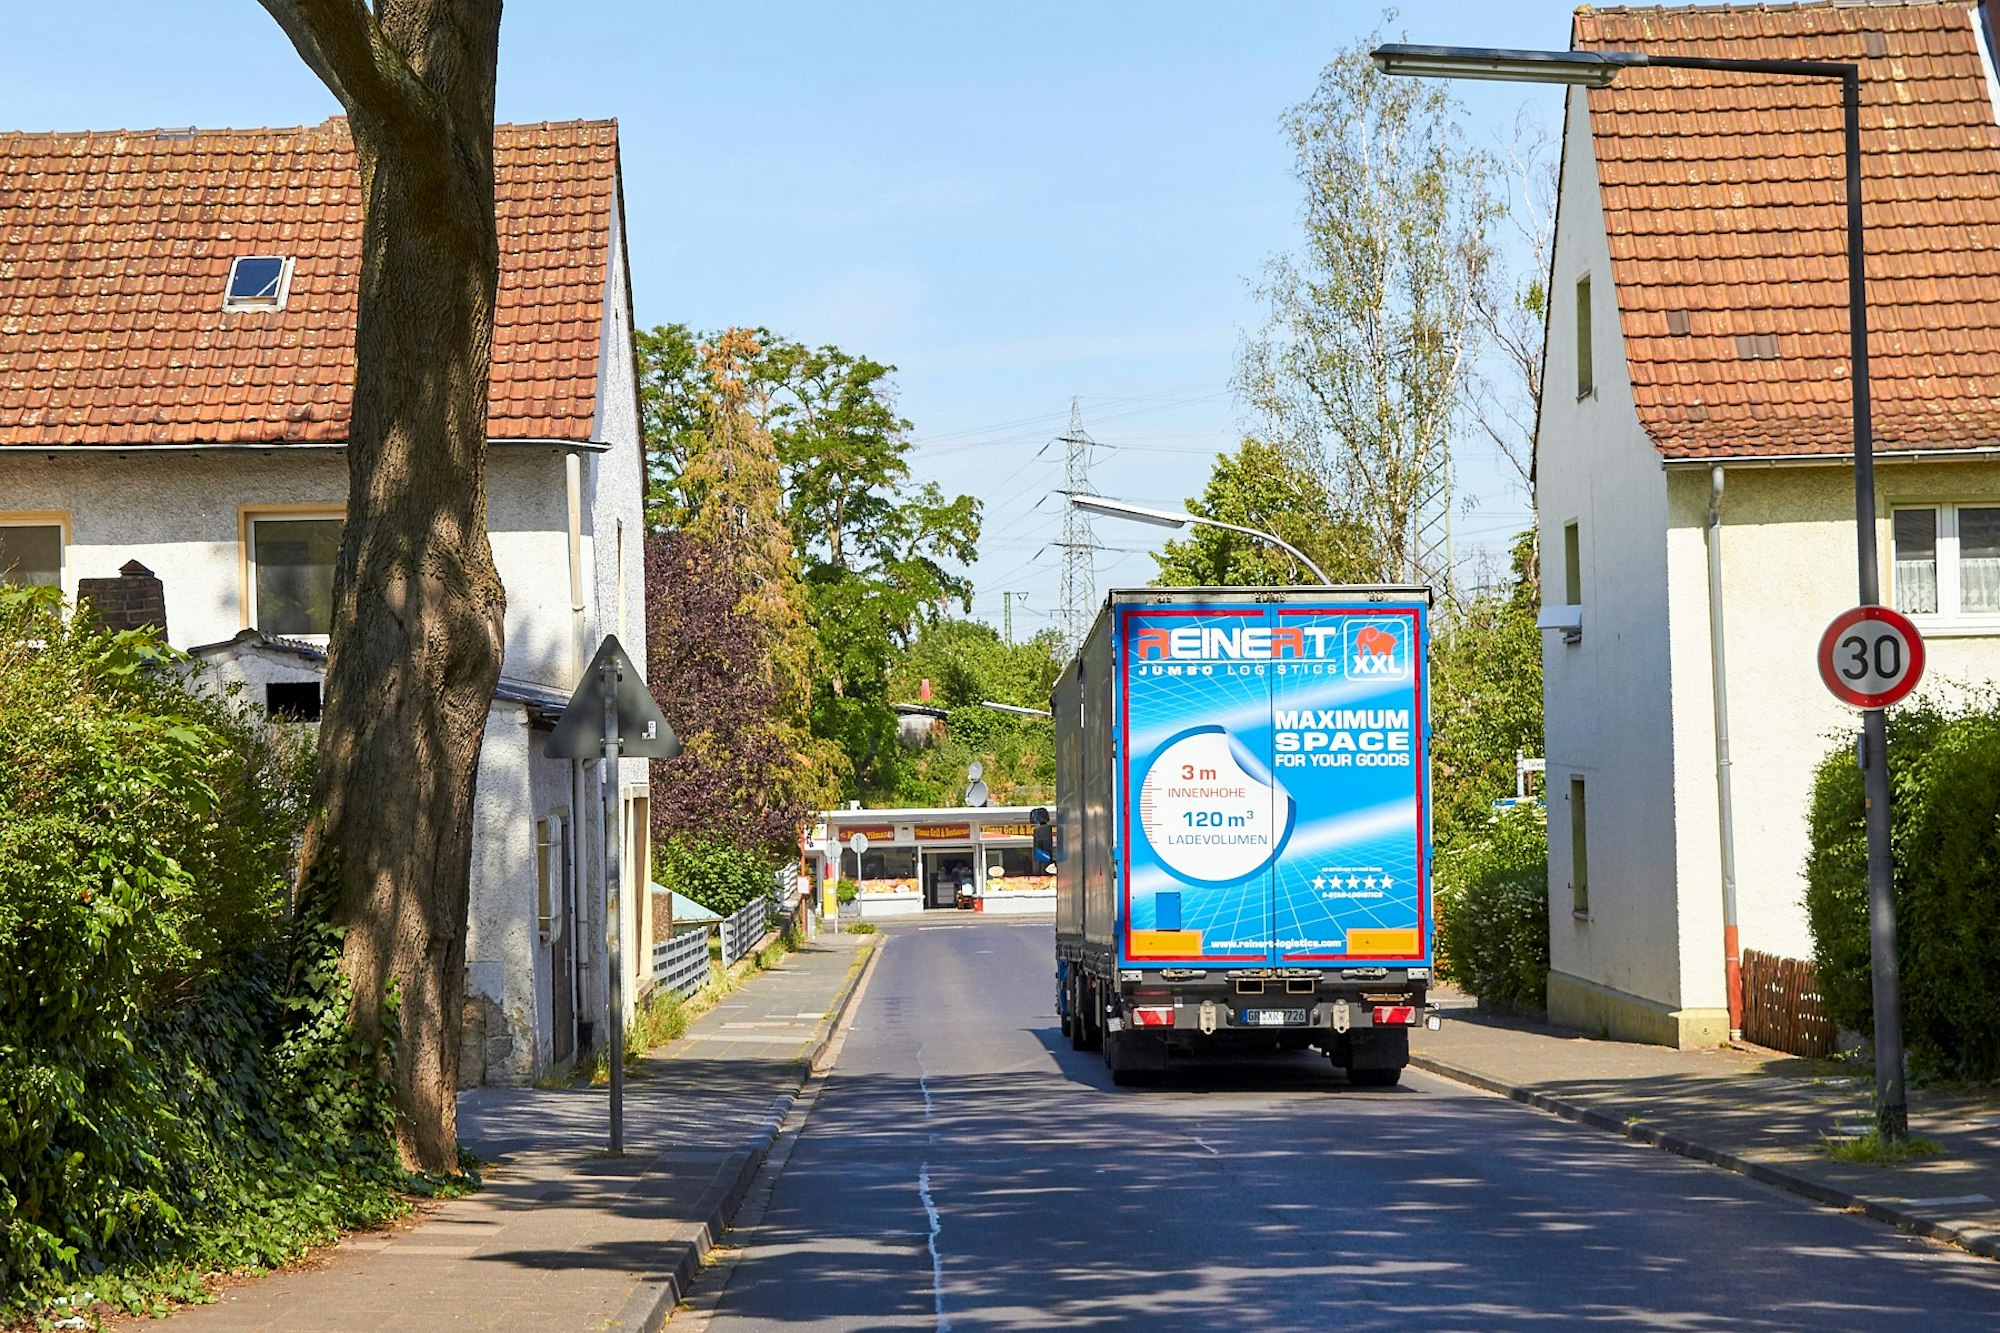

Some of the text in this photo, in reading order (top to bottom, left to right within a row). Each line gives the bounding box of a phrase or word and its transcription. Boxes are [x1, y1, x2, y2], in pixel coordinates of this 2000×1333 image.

[1138, 627, 1336, 659] REINERT
[1352, 655, 1402, 674] XXL
[1842, 635, 1900, 680] 30
[1138, 664, 1337, 676] JUMBO LOGSTICS
[1275, 710, 1409, 730] MAXIMUM
[1275, 732, 1409, 751] SPACE
[1275, 752, 1409, 767] FOR YOUR GOODS
[1181, 765, 1217, 780] 3 m
[1182, 811, 1223, 827] 120
[1168, 834, 1268, 846] LADEVOLUMEN
